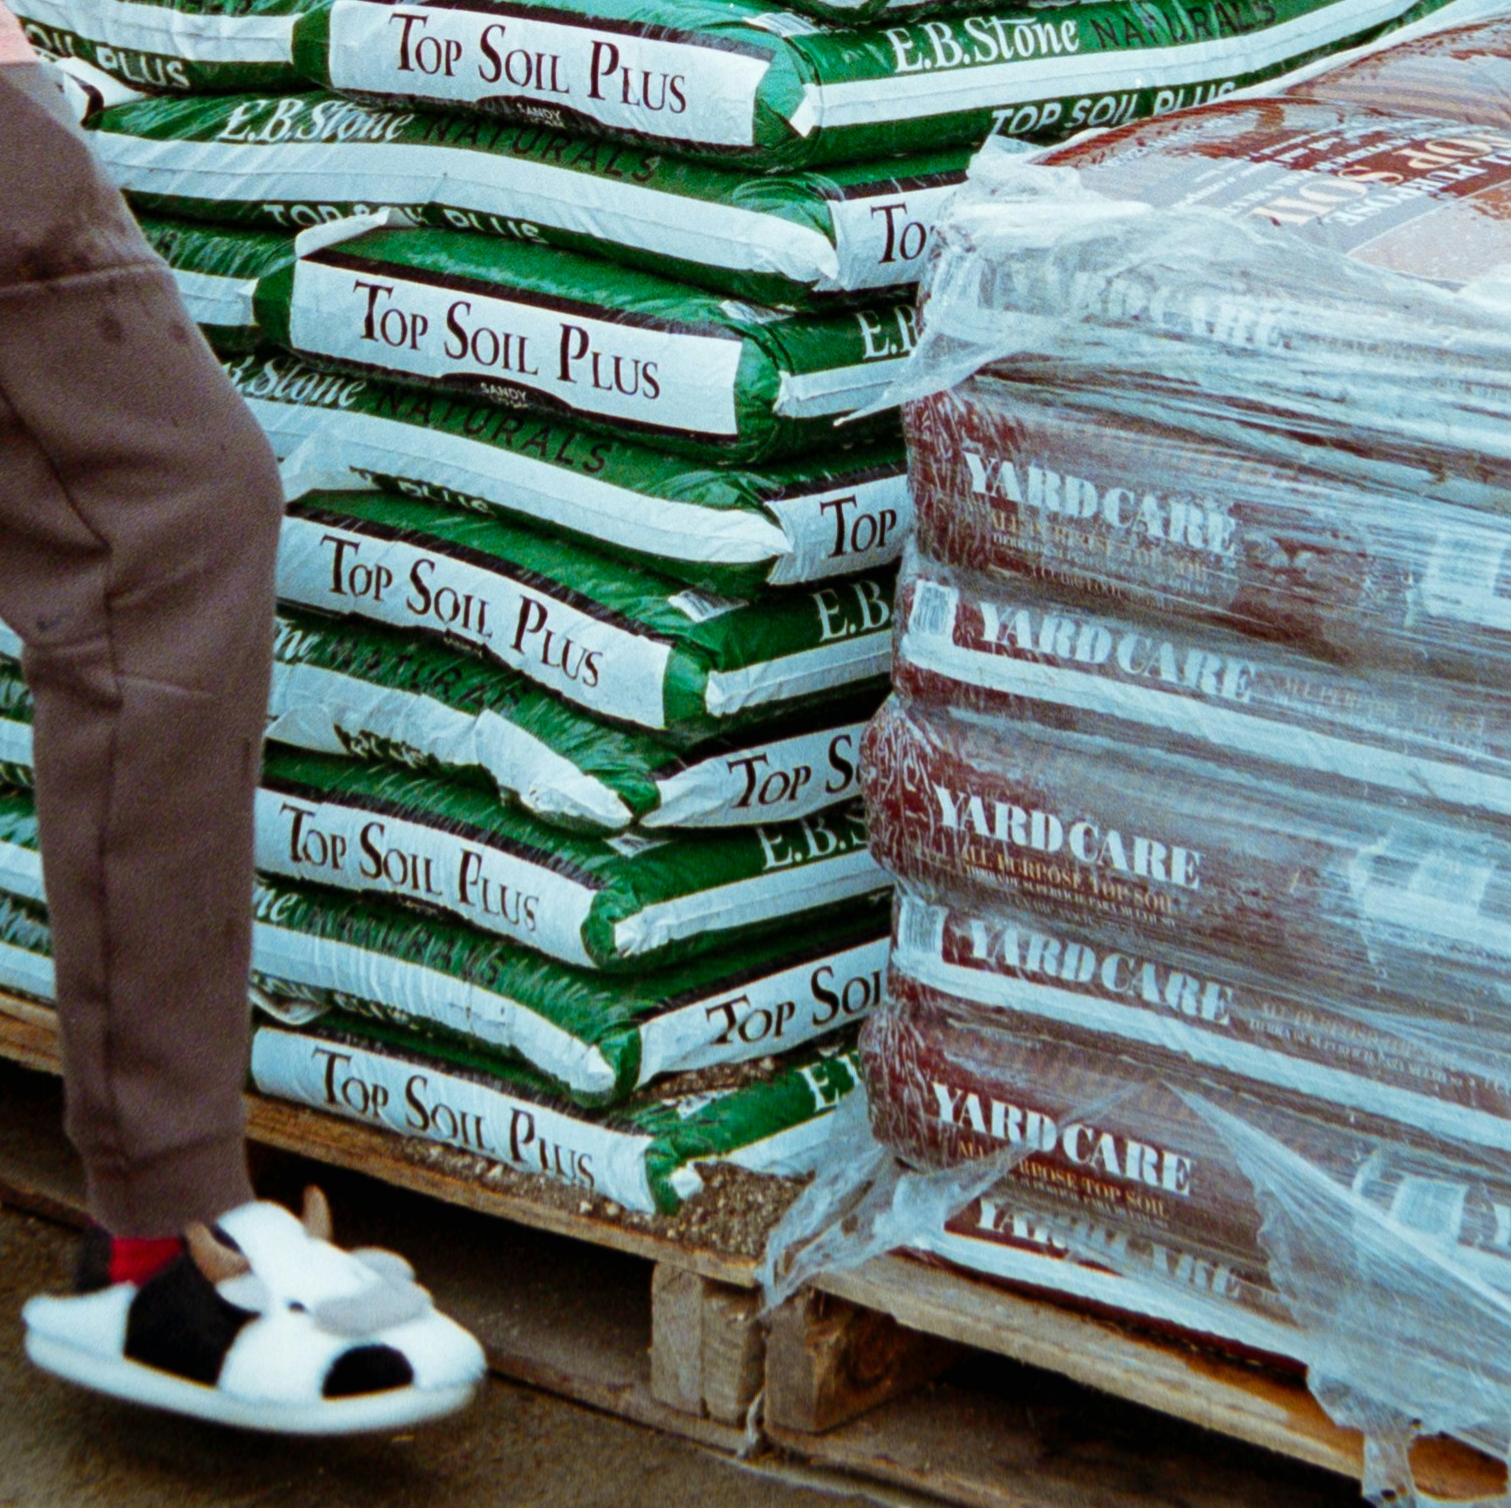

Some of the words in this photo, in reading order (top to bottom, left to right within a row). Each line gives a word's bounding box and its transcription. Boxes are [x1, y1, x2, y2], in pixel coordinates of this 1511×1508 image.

[389, 13, 464, 78] TOP
[478, 24, 569, 94] SOIL
[588, 39, 687, 114] PLUS
[423, 115, 657, 182] NATURALS
[989, 100, 1060, 135] TOP
[1068, 91, 1142, 128] SOIL
[872, 203, 929, 264] TO
[353, 280, 428, 350] TOP
[444, 301, 538, 375] SOIL
[556, 323, 660, 400] PLUS
[375, 394, 611, 474] NATURALS
[819, 496, 897, 559] TOP
[321, 534, 393, 600] TOP
[406, 559, 494, 638] SOIL
[510, 594, 603, 688] PLUS
[727, 754, 810, 809] TOP
[280, 803, 347, 871] TOP
[359, 823, 442, 896] SOIL
[457, 850, 539, 931] PLUS
[705, 995, 795, 1047] TOP
[810, 966, 889, 1024] SOI
[312, 1046, 389, 1118] TOP
[404, 1075, 495, 1152] SOIL
[508, 1106, 595, 1189] PLUS
